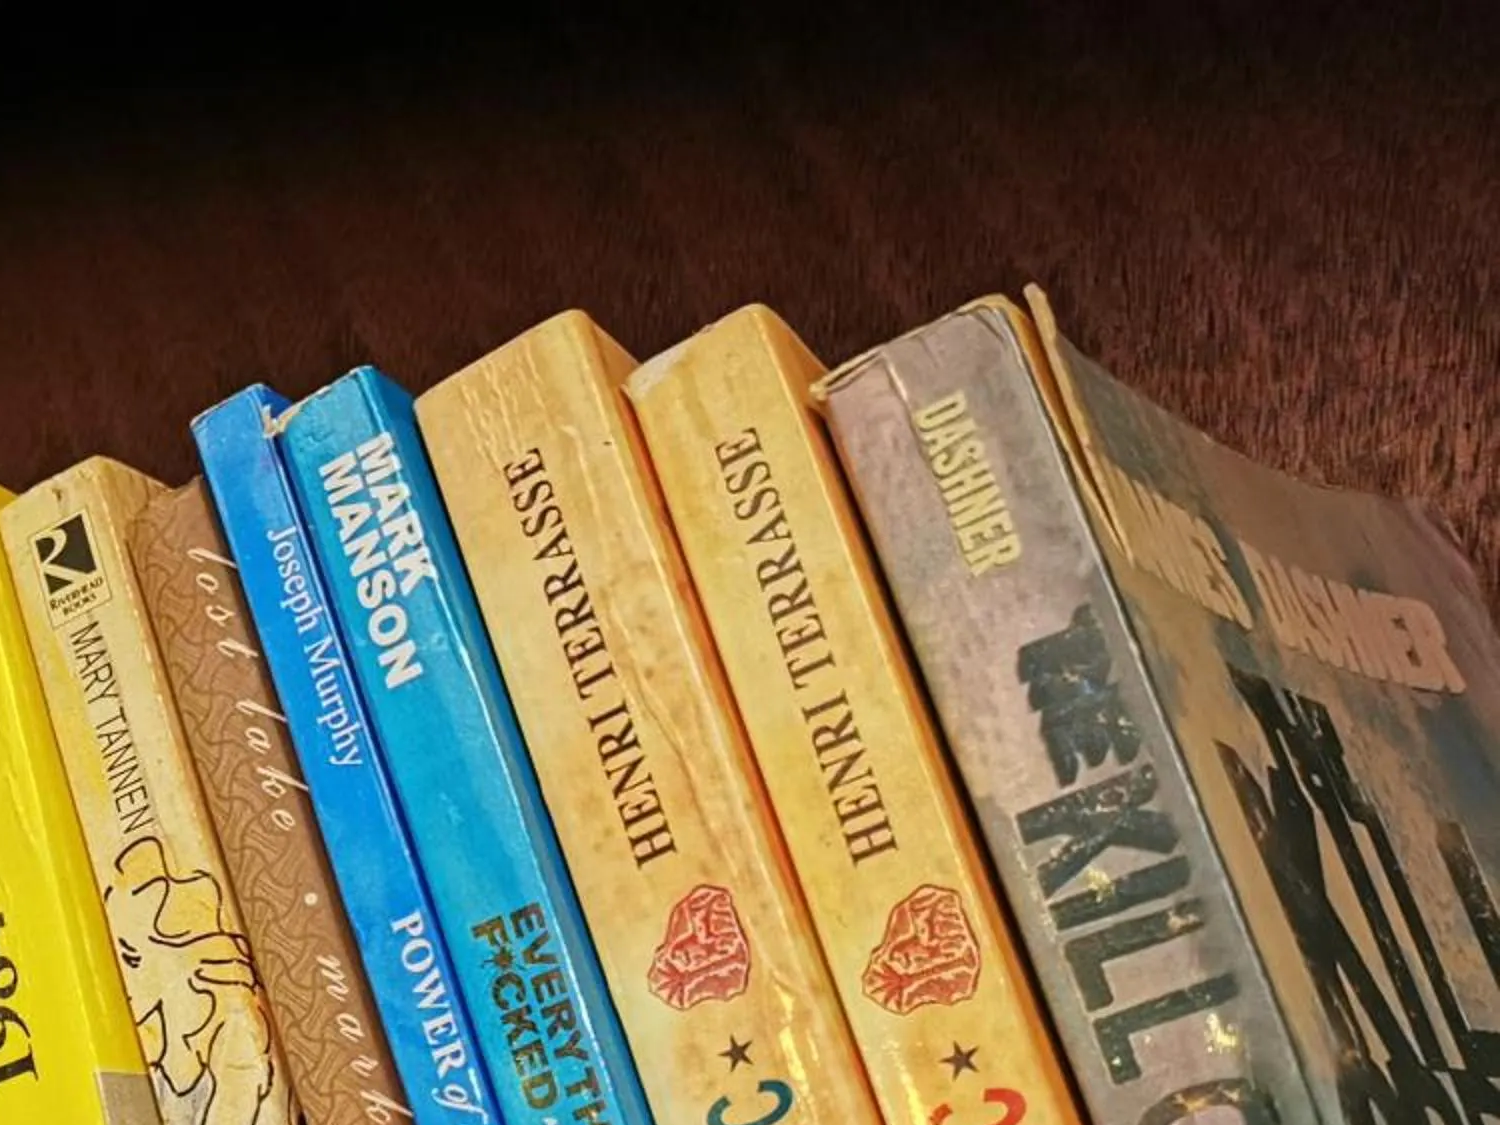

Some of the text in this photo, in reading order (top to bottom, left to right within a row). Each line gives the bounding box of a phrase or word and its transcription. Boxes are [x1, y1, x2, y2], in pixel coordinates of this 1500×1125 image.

[318, 450, 424, 690] MANSON
[357, 431, 438, 596] MARK
[917, 389, 1022, 582] DASHNER
[69, 619, 155, 835] MARY TANNEN
[189, 547, 309, 831] lost lake
[266, 523, 364, 768] Joseph Murphy
[503, 446, 678, 871] HENRI TERRASSE
[714, 426, 899, 869] HENRI TERRASSE
[317, 954, 414, 1125] mark
[389, 909, 468, 1081] POWER
[1015, 760, 1242, 1086] KILL
